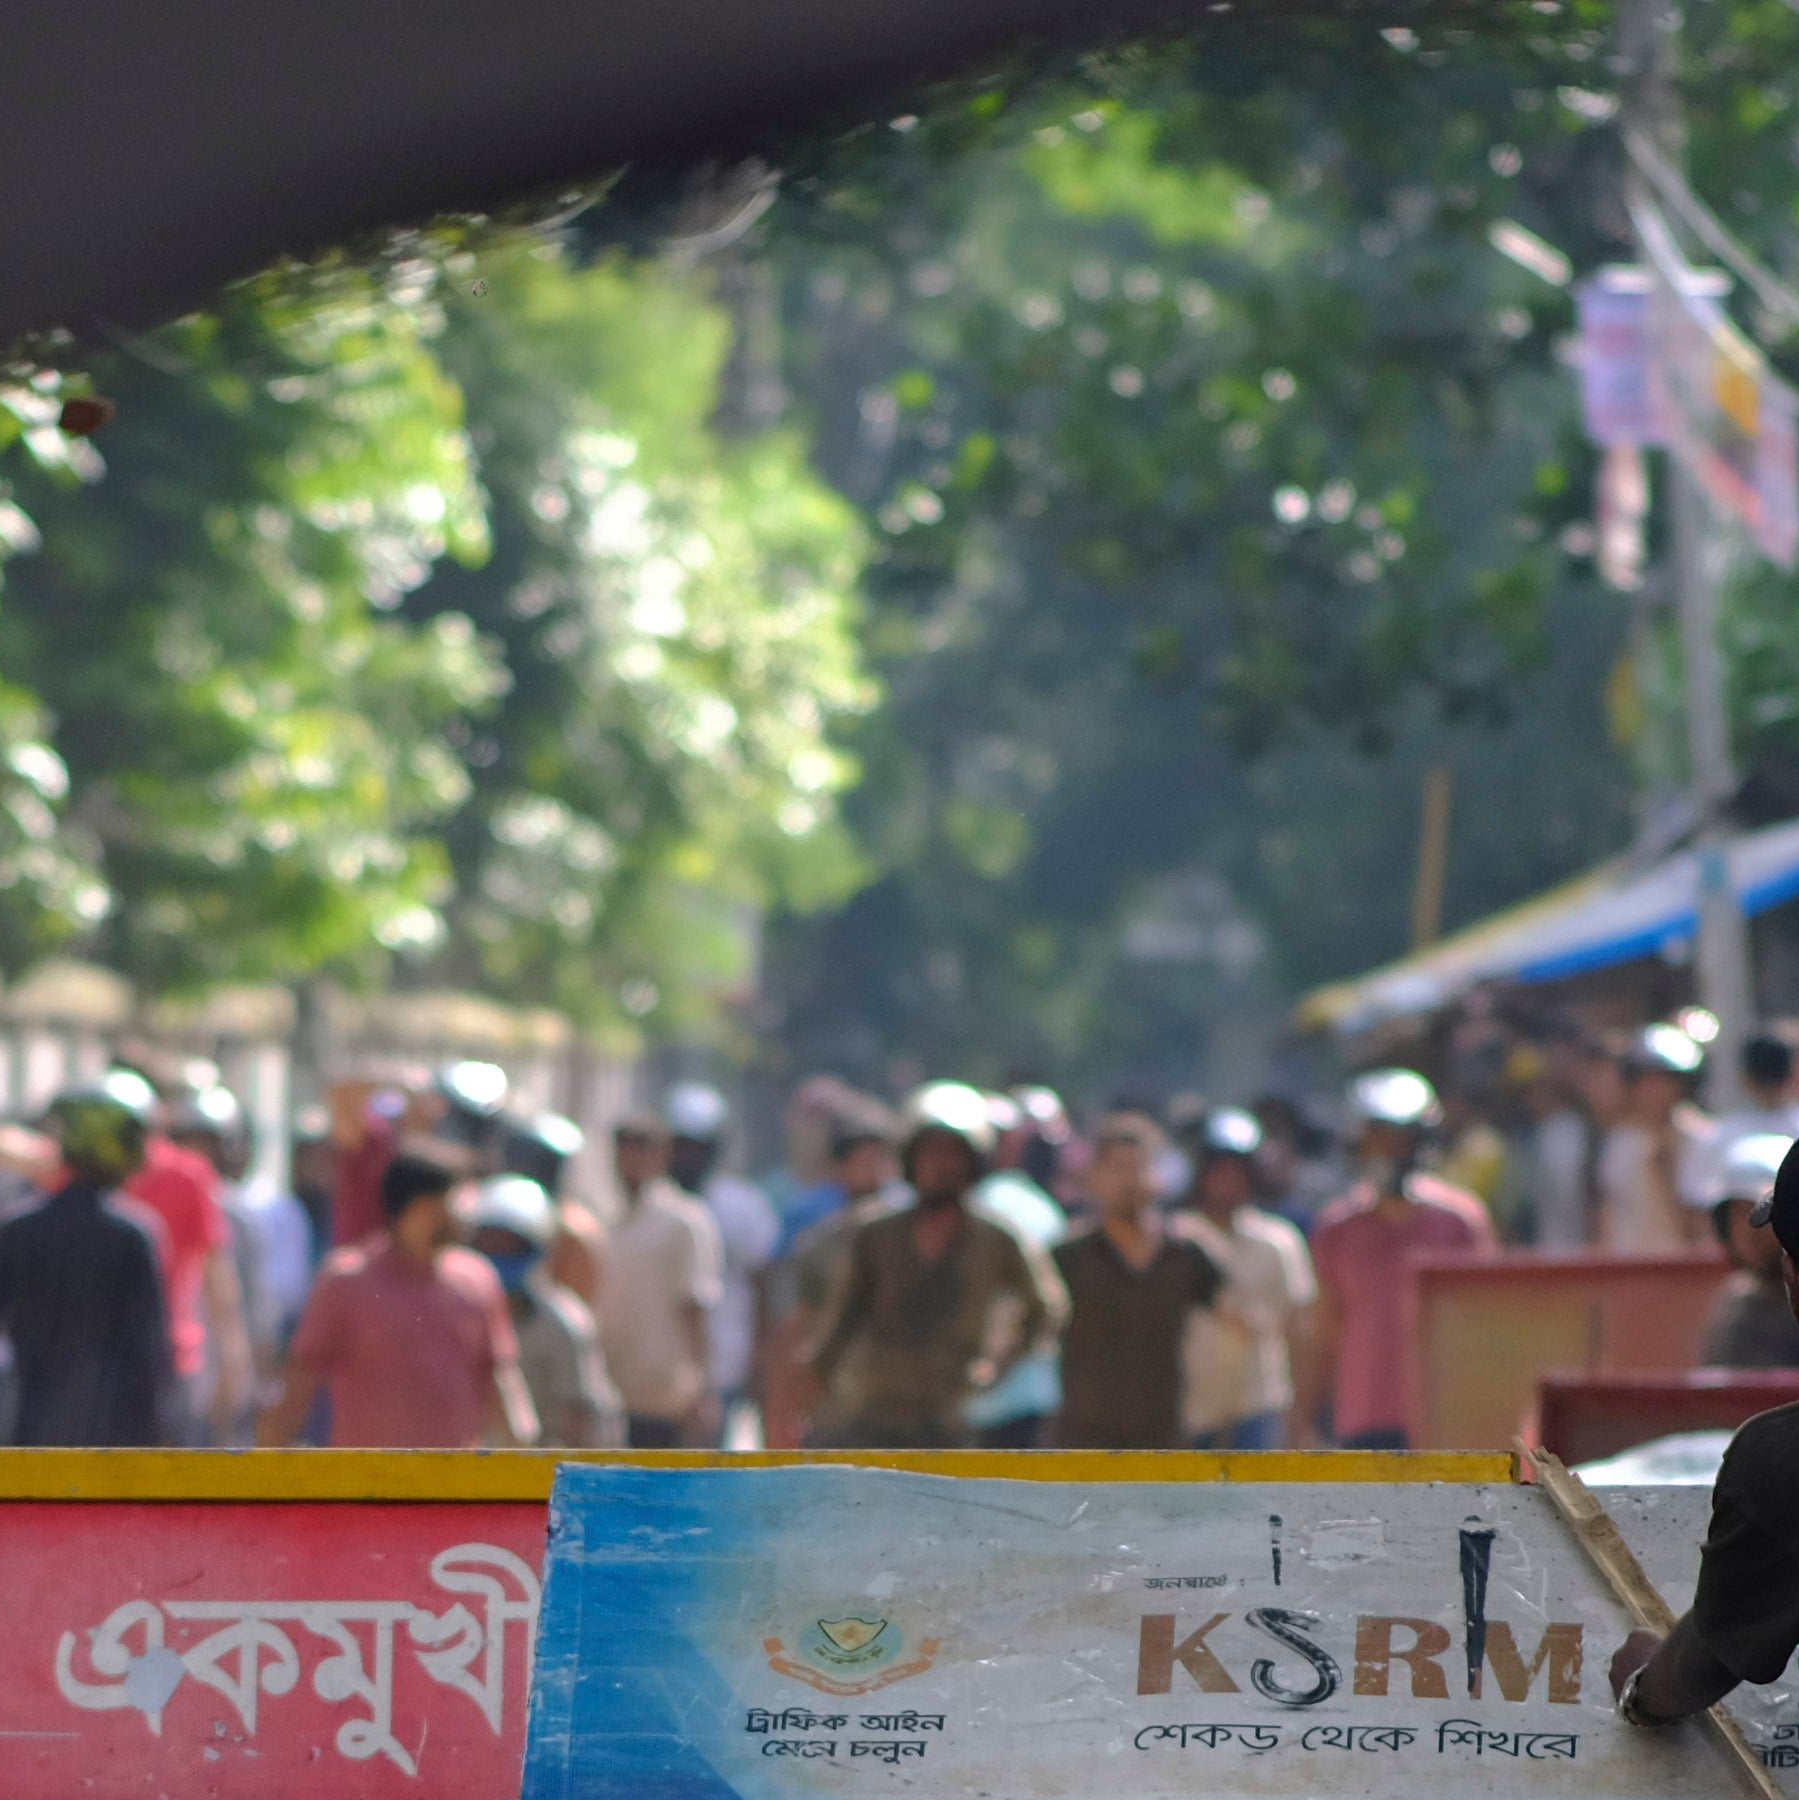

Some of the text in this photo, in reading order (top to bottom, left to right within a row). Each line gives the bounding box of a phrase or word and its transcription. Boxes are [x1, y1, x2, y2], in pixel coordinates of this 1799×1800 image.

[56, 1543, 540, 1779] একমুখী
[1136, 1607, 1584, 1706] KSRM
[745, 1707, 947, 1733] ট্রাফিক আইন
[1134, 1718, 1581, 1761] শেকড় থেকে শিখরে
[762, 1739, 929, 1765] মেনে চলুন
